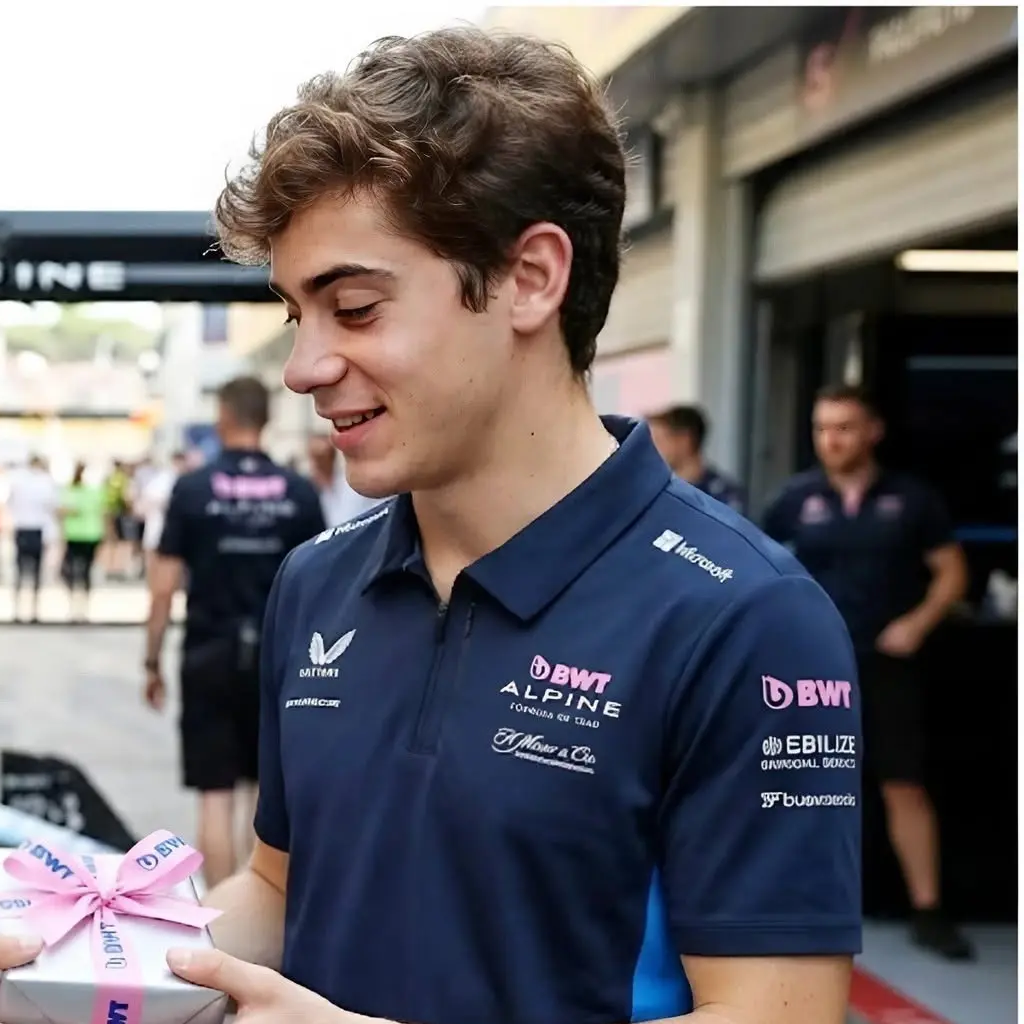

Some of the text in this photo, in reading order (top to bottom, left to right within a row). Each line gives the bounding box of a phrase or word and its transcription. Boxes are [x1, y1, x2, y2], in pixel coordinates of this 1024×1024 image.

[550, 664, 612, 694] BWT
[796, 679, 851, 708] BWT
[499, 680, 623, 718] ALPINE
